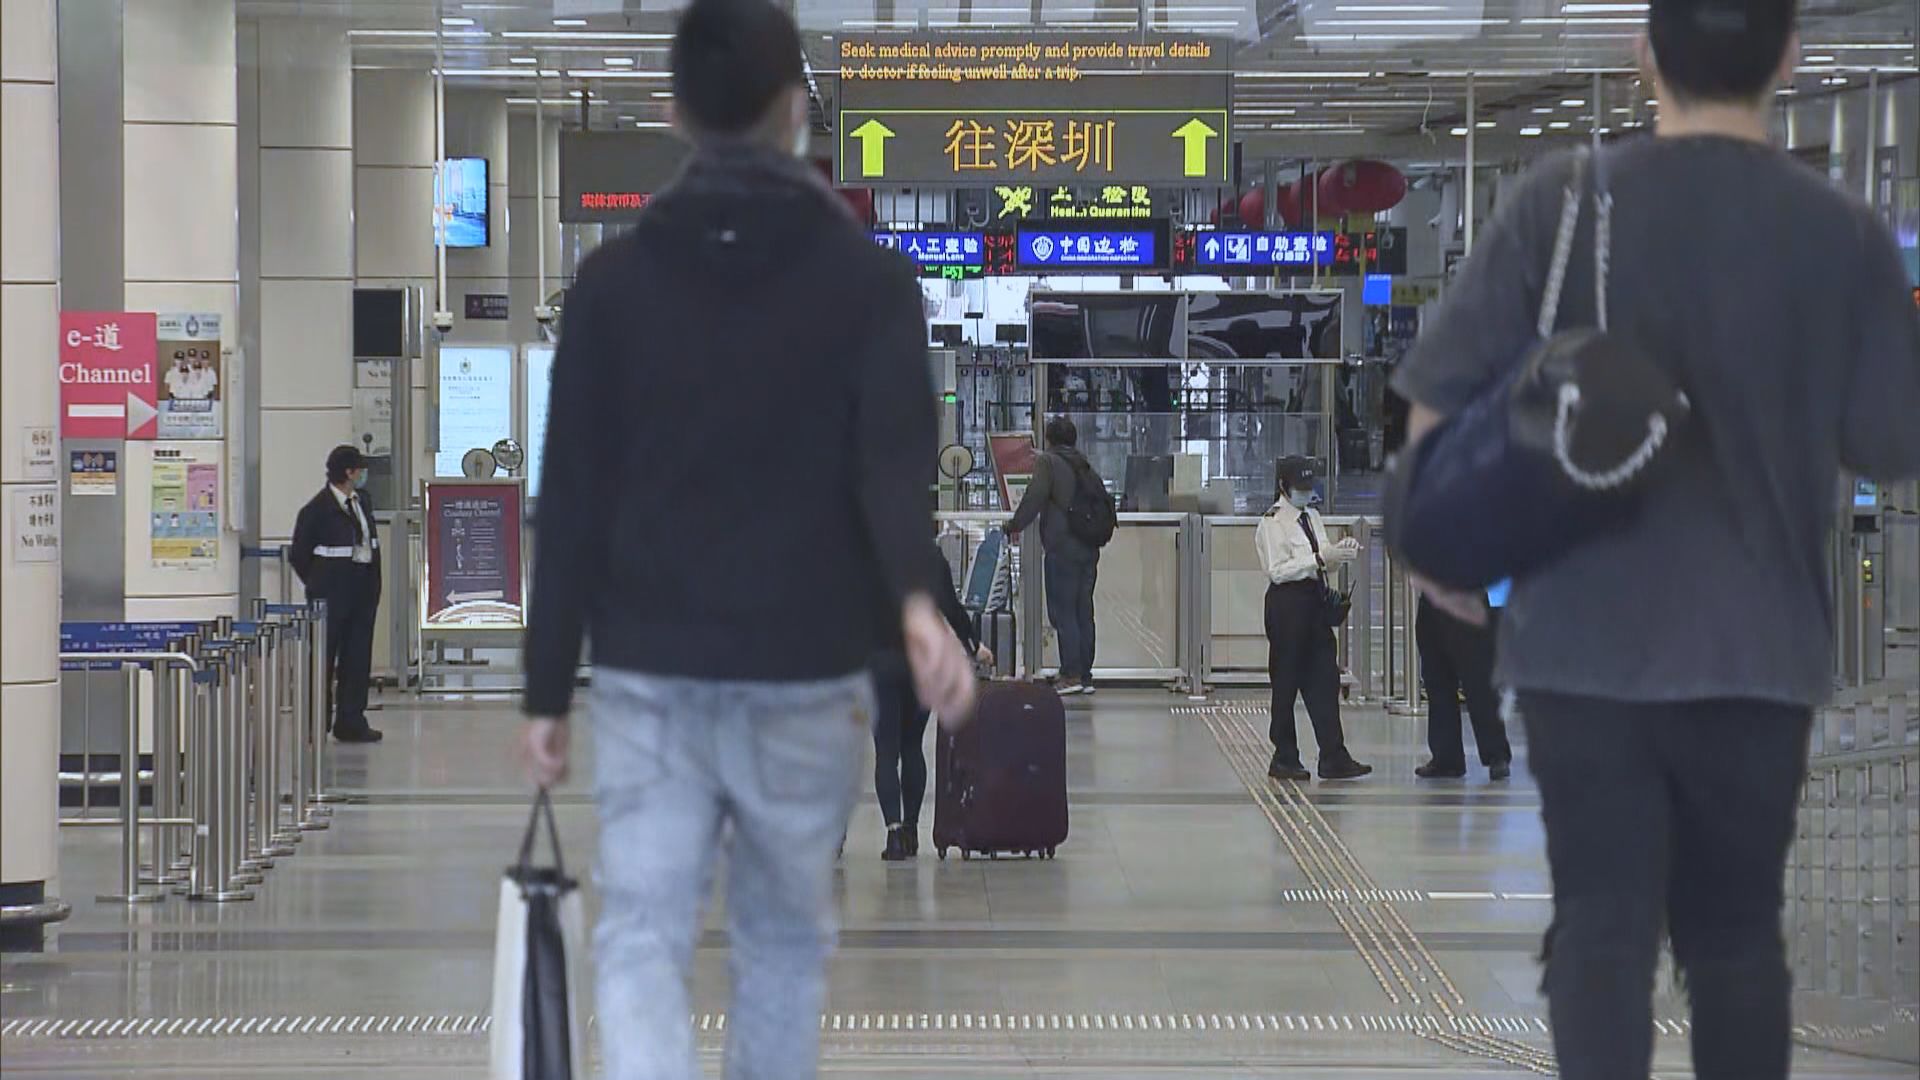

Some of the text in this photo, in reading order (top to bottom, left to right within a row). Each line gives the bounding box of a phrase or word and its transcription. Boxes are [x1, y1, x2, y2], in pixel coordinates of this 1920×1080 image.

[840, 41, 1211, 61] Seek medical advice promptly and provide travel details
[840, 63, 1082, 83] to doctor if feeling unwell after a trip.
[944, 119, 1116, 172] 往深圳
[1060, 235, 1139, 254] 中国边检
[67, 322, 123, 351] e-道
[59, 362, 151, 384] Channel
